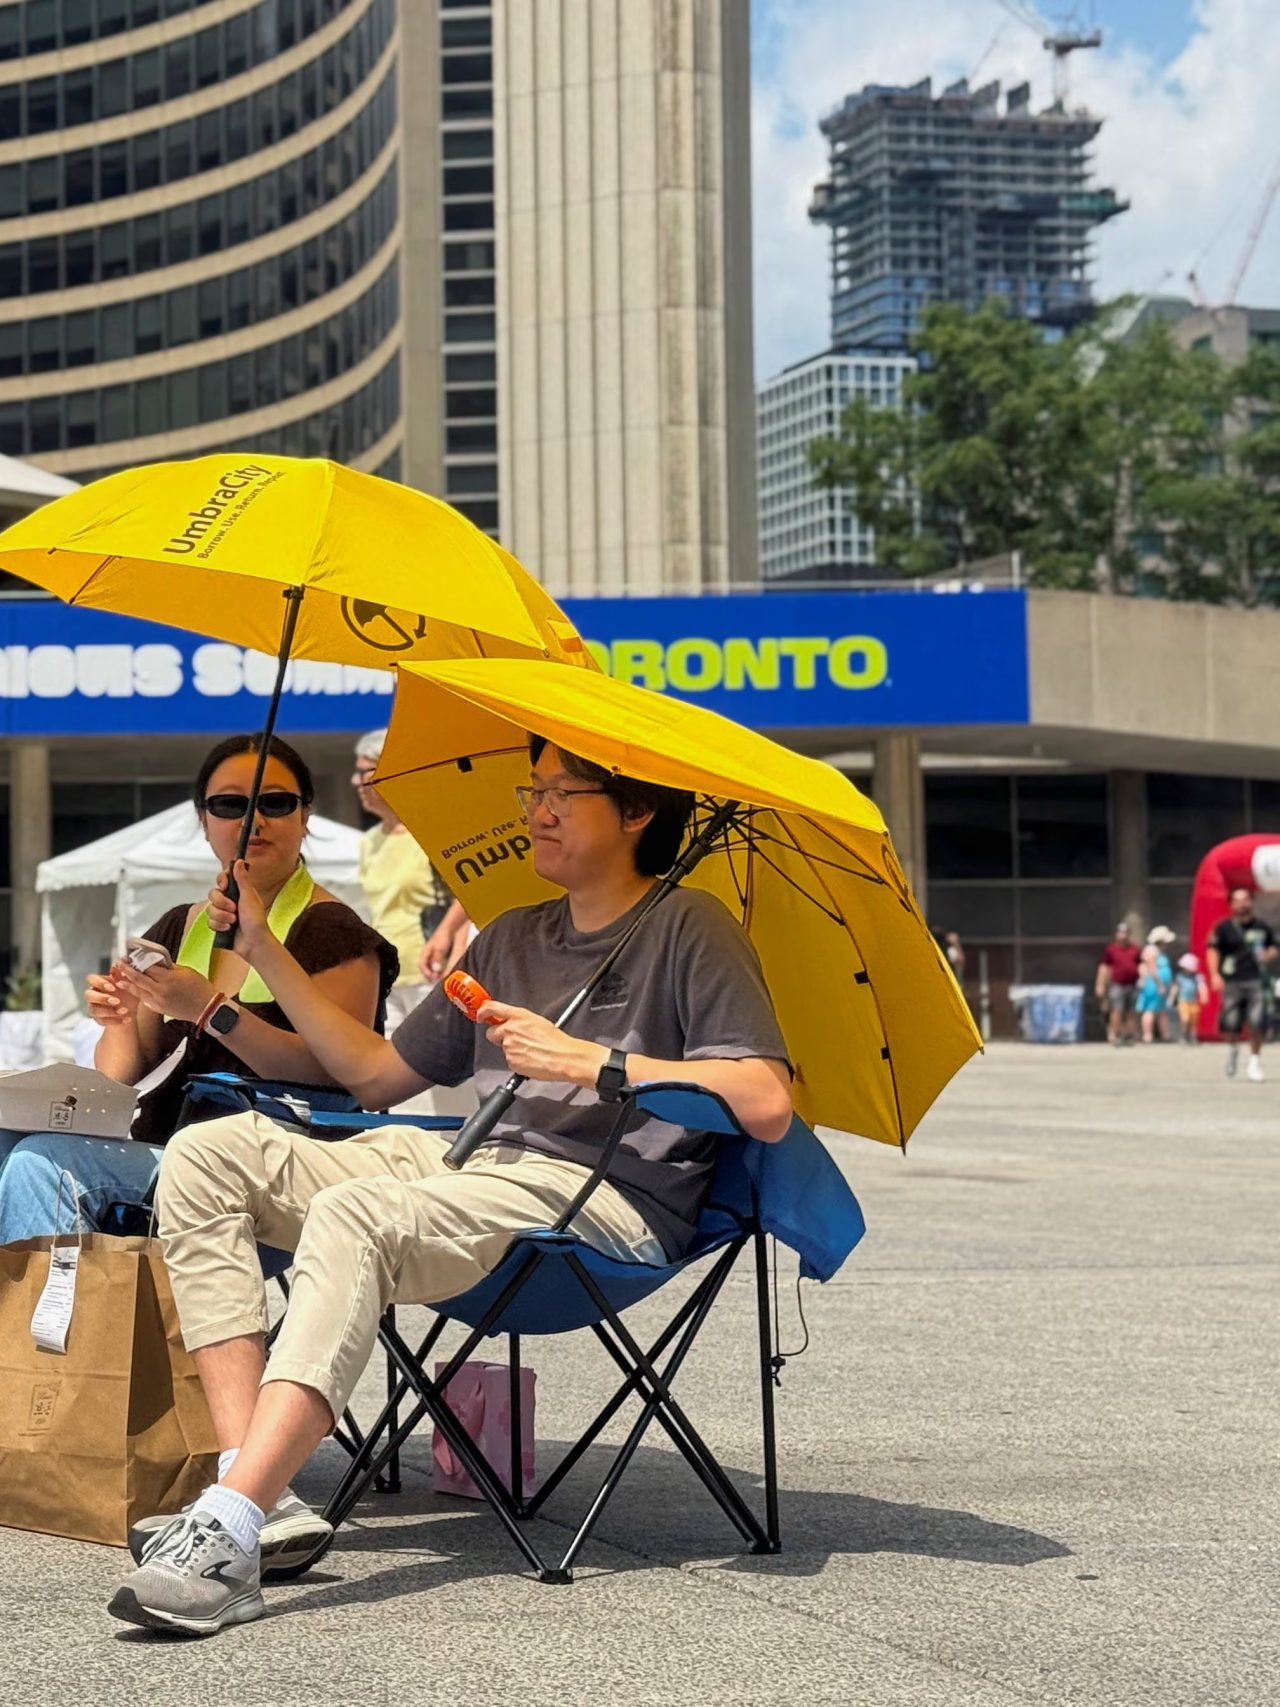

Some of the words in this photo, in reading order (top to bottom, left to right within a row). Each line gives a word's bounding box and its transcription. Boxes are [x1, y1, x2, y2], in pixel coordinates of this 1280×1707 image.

[162, 464, 272, 554] UmbraCity
[196, 527, 229, 559] Borrow.
[221, 511, 242, 527] Use.
